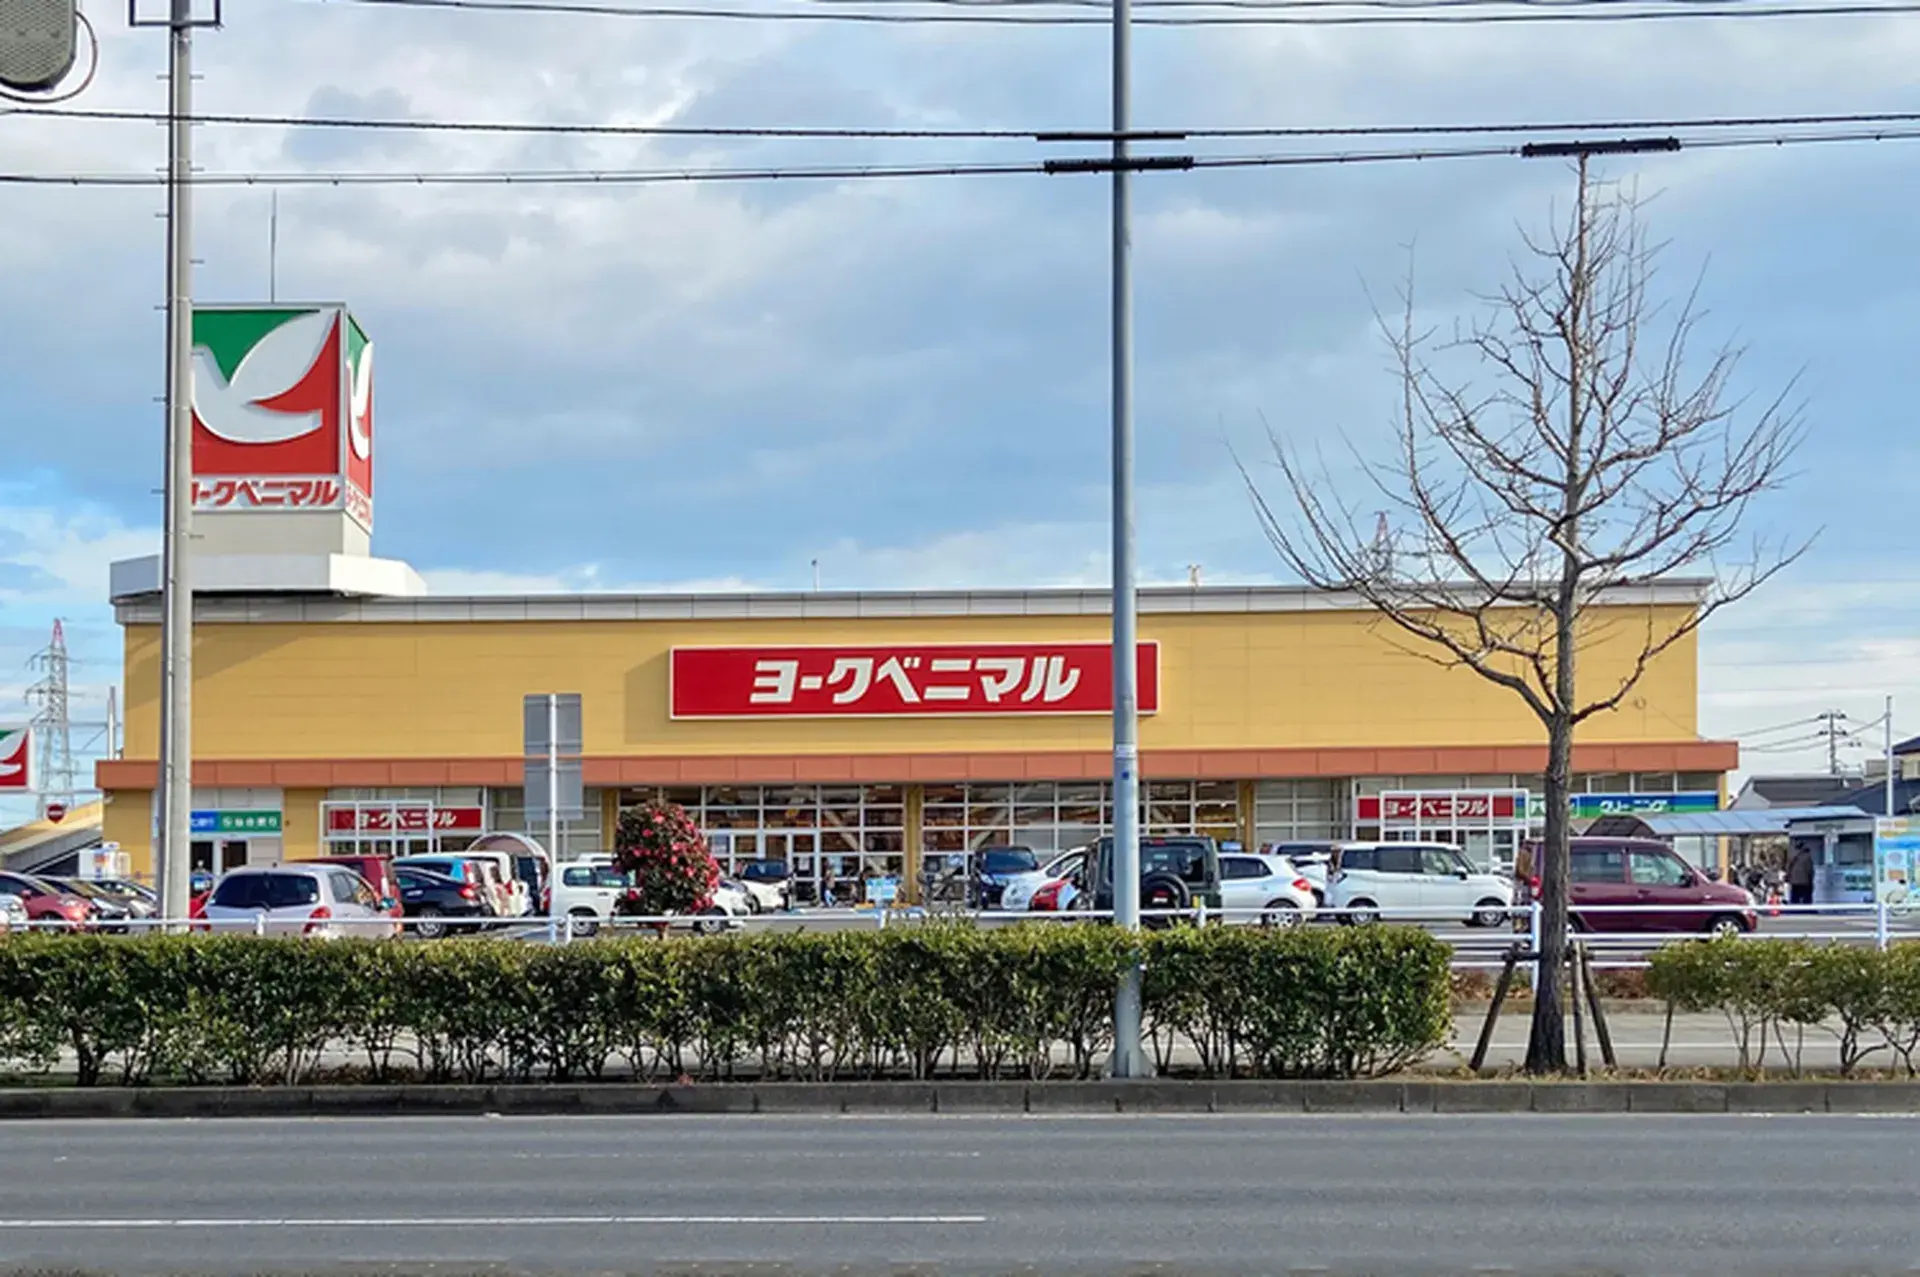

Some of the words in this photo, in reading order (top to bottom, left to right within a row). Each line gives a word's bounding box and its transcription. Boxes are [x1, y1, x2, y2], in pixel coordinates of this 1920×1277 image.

[749, 656, 1081, 703] ヨークベニマル
[1385, 800, 1489, 816] ヨークベニマル
